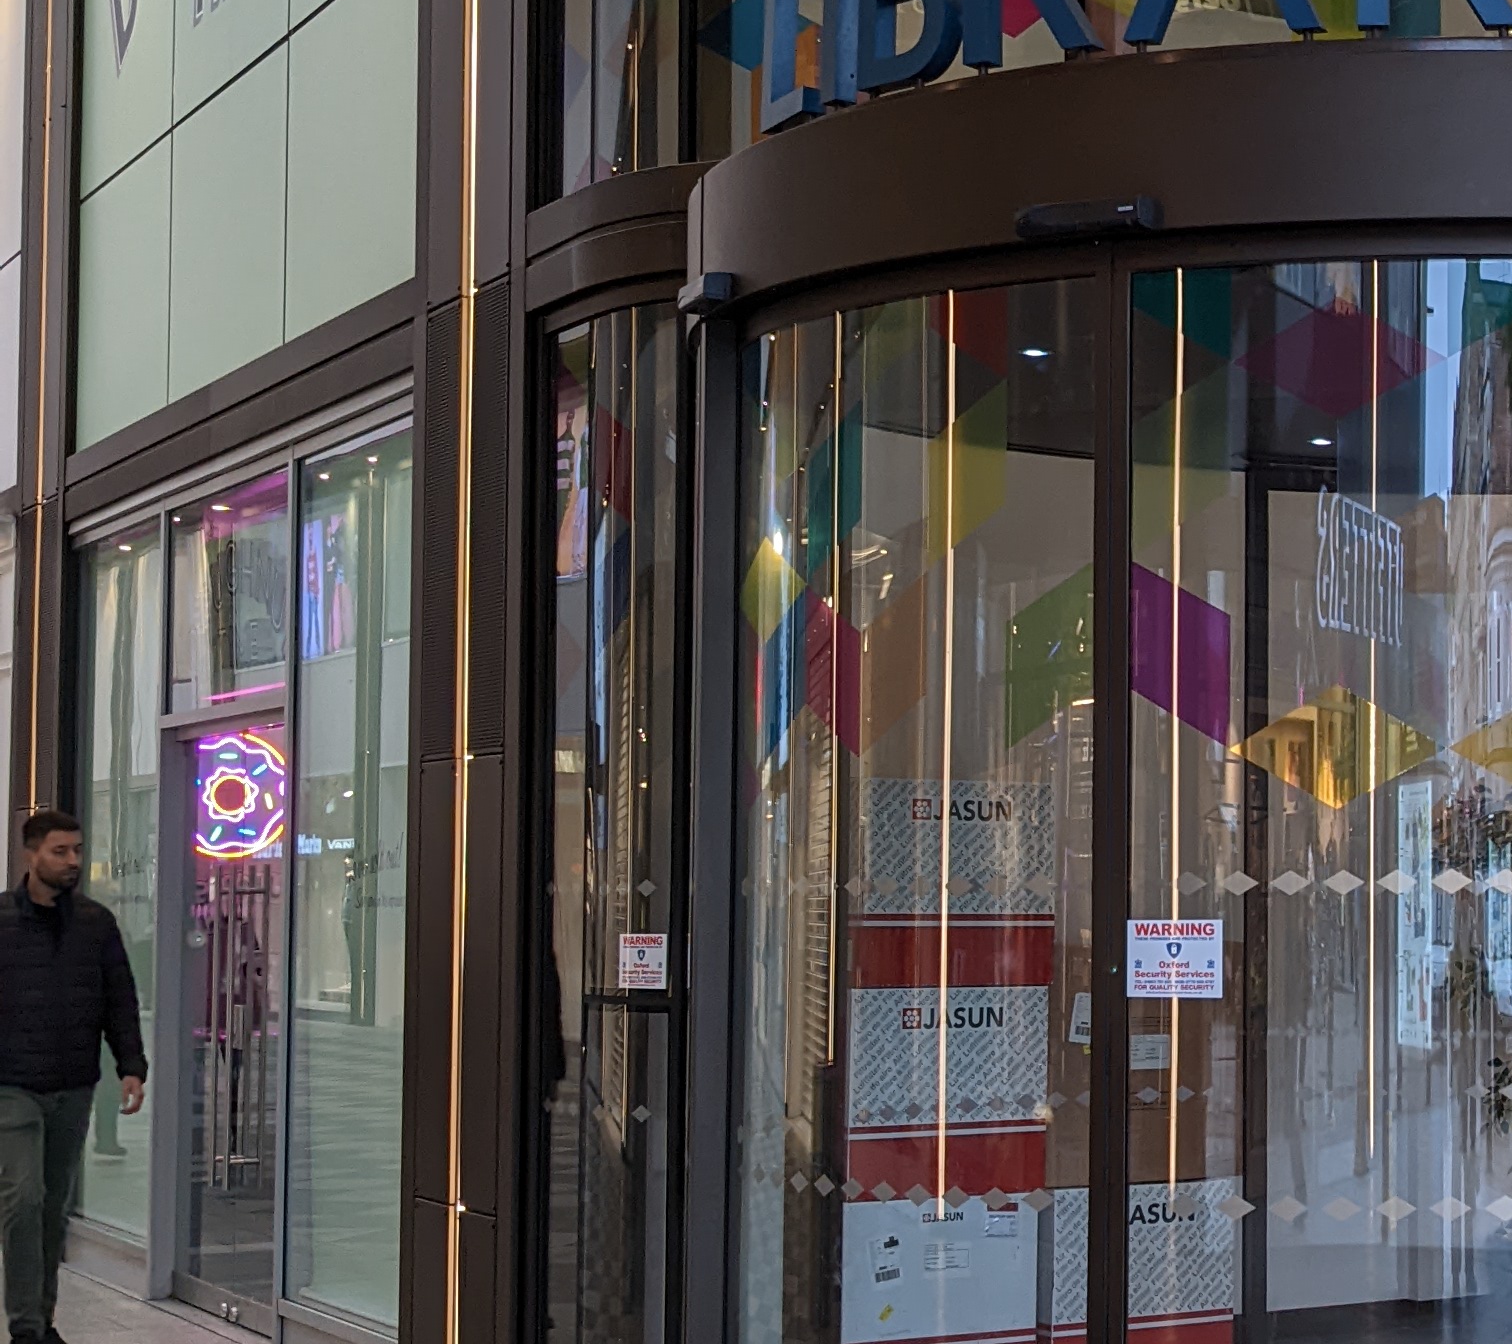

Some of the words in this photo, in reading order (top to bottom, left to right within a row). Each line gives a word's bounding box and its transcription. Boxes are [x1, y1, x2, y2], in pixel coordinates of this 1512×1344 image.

[933, 800, 1012, 822] JASUN
[326, 838, 354, 850] VAN
[1134, 922, 1215, 936] WARNING
[623, 936, 663, 946] WARNING
[1158, 960, 1190, 968] Oxford
[1134, 970, 1172, 980] Security
[1174, 970, 1214, 978] Services
[923, 1007, 1003, 1029] JASUN
[931, 1212, 964, 1222] JSUN
